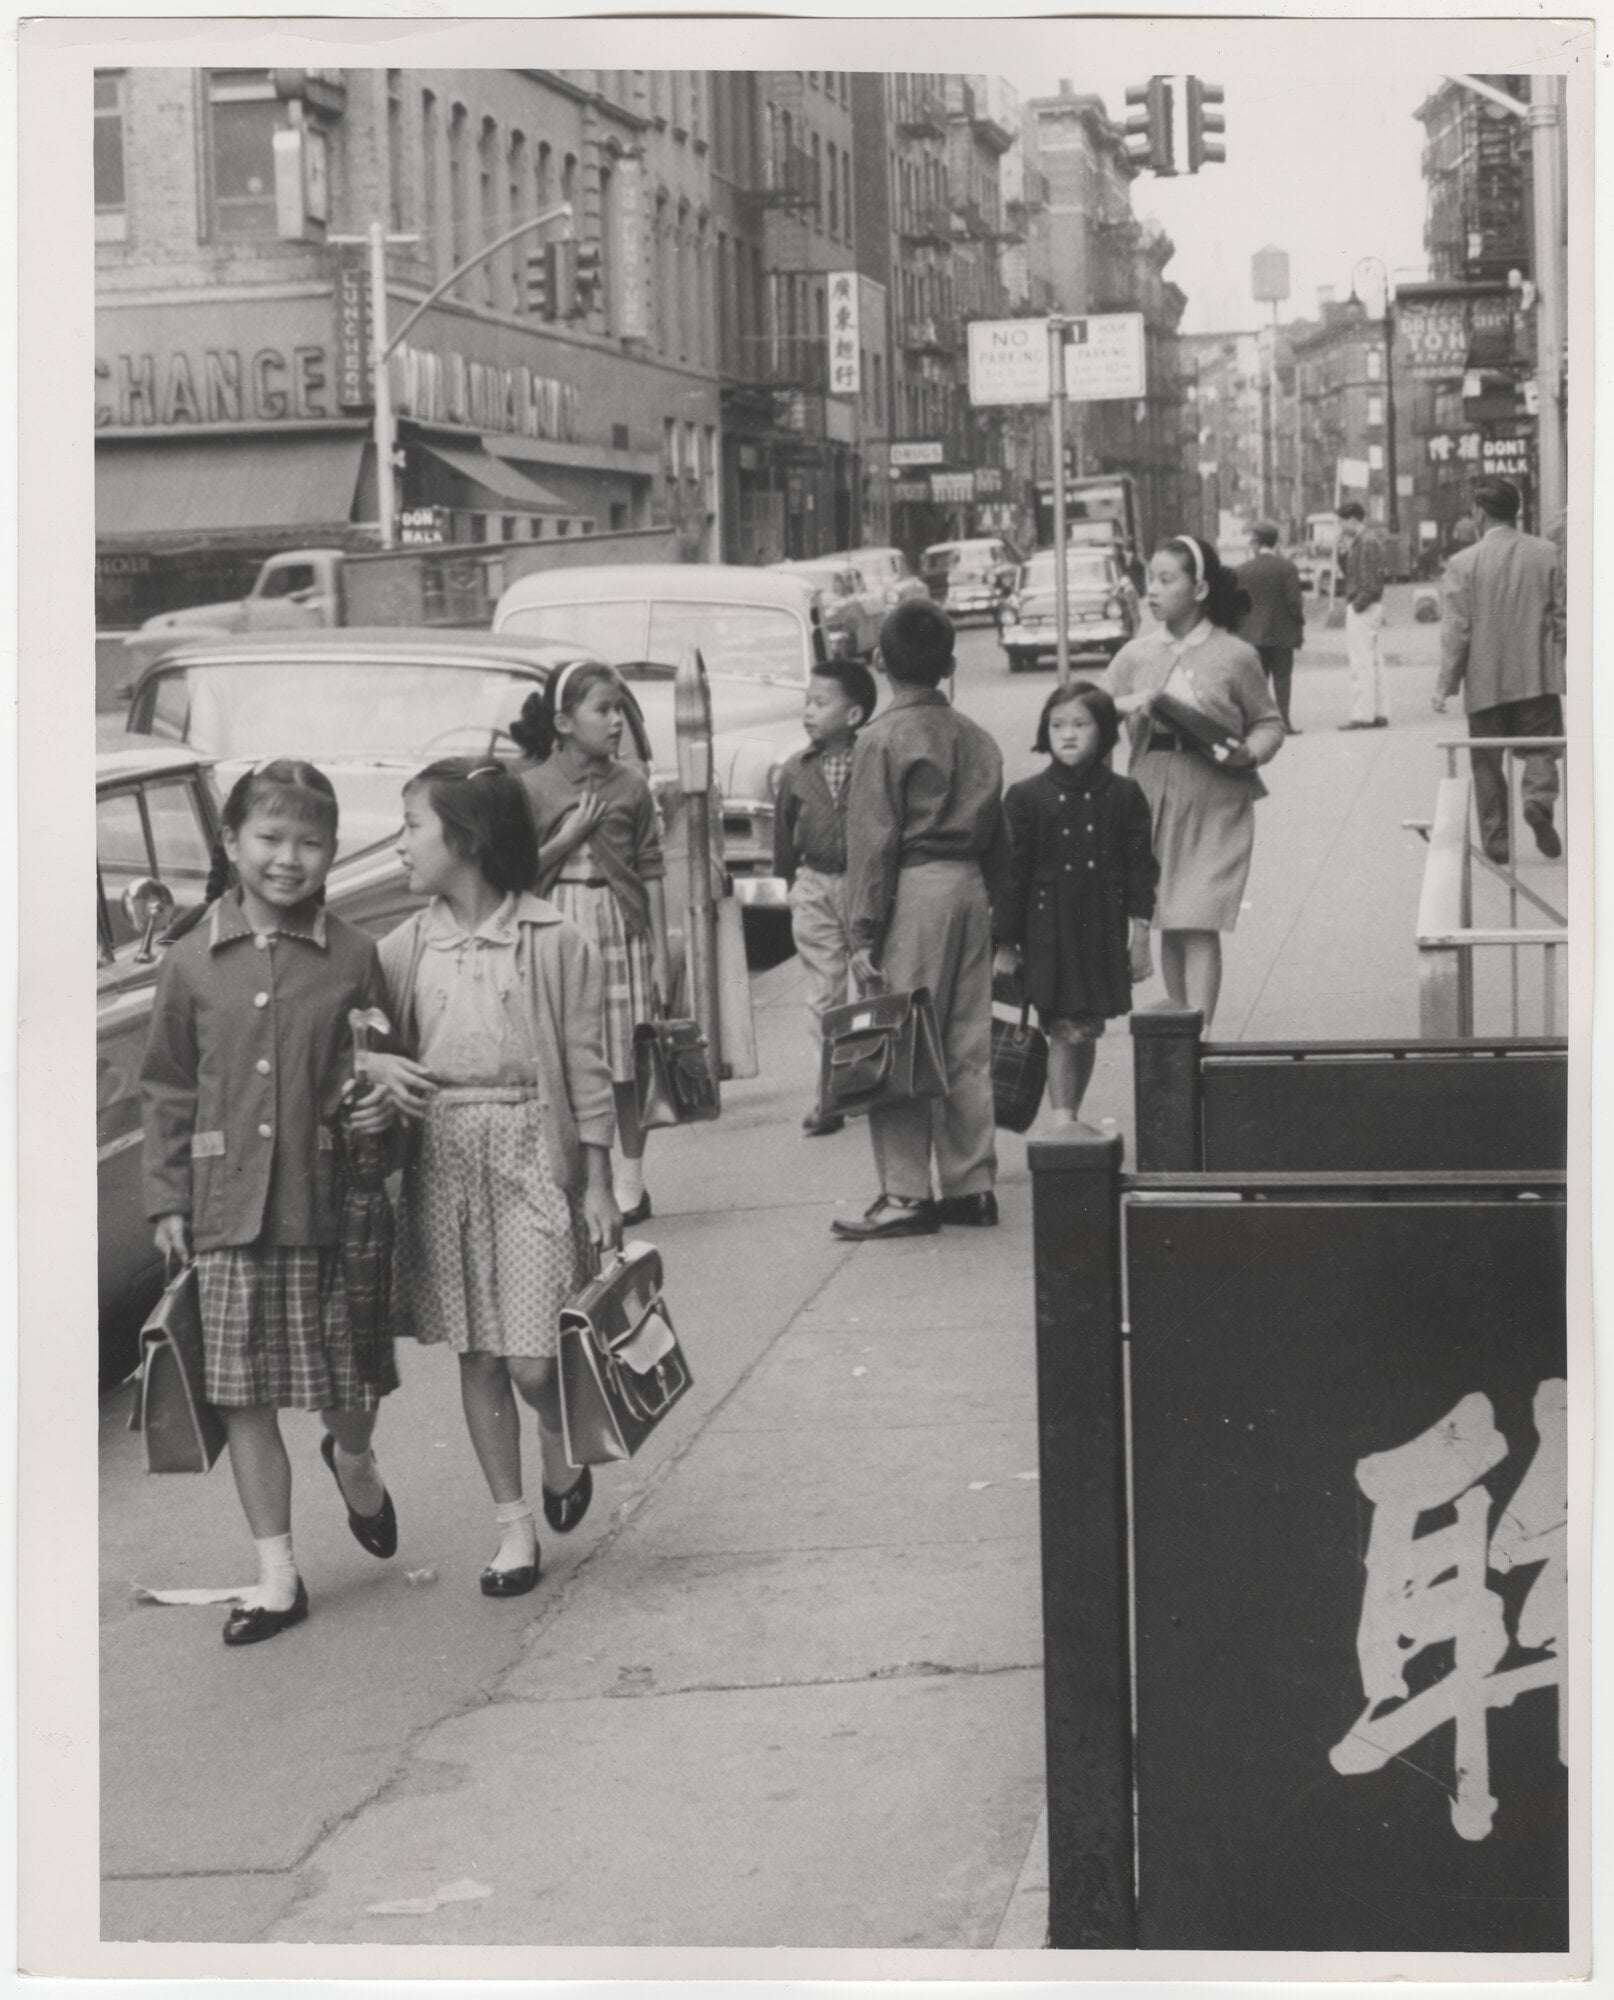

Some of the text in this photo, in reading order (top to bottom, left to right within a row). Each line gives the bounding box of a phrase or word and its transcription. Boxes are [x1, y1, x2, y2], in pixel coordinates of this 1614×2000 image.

[992, 330, 1028, 346] NO
[979, 350, 1042, 364] PARKING
[1078, 347, 1127, 359] PARKING
[893, 447, 941, 461] DRUGS
[1484, 440, 1525, 456] DONT
[1484, 459, 1528, 474] WALK
